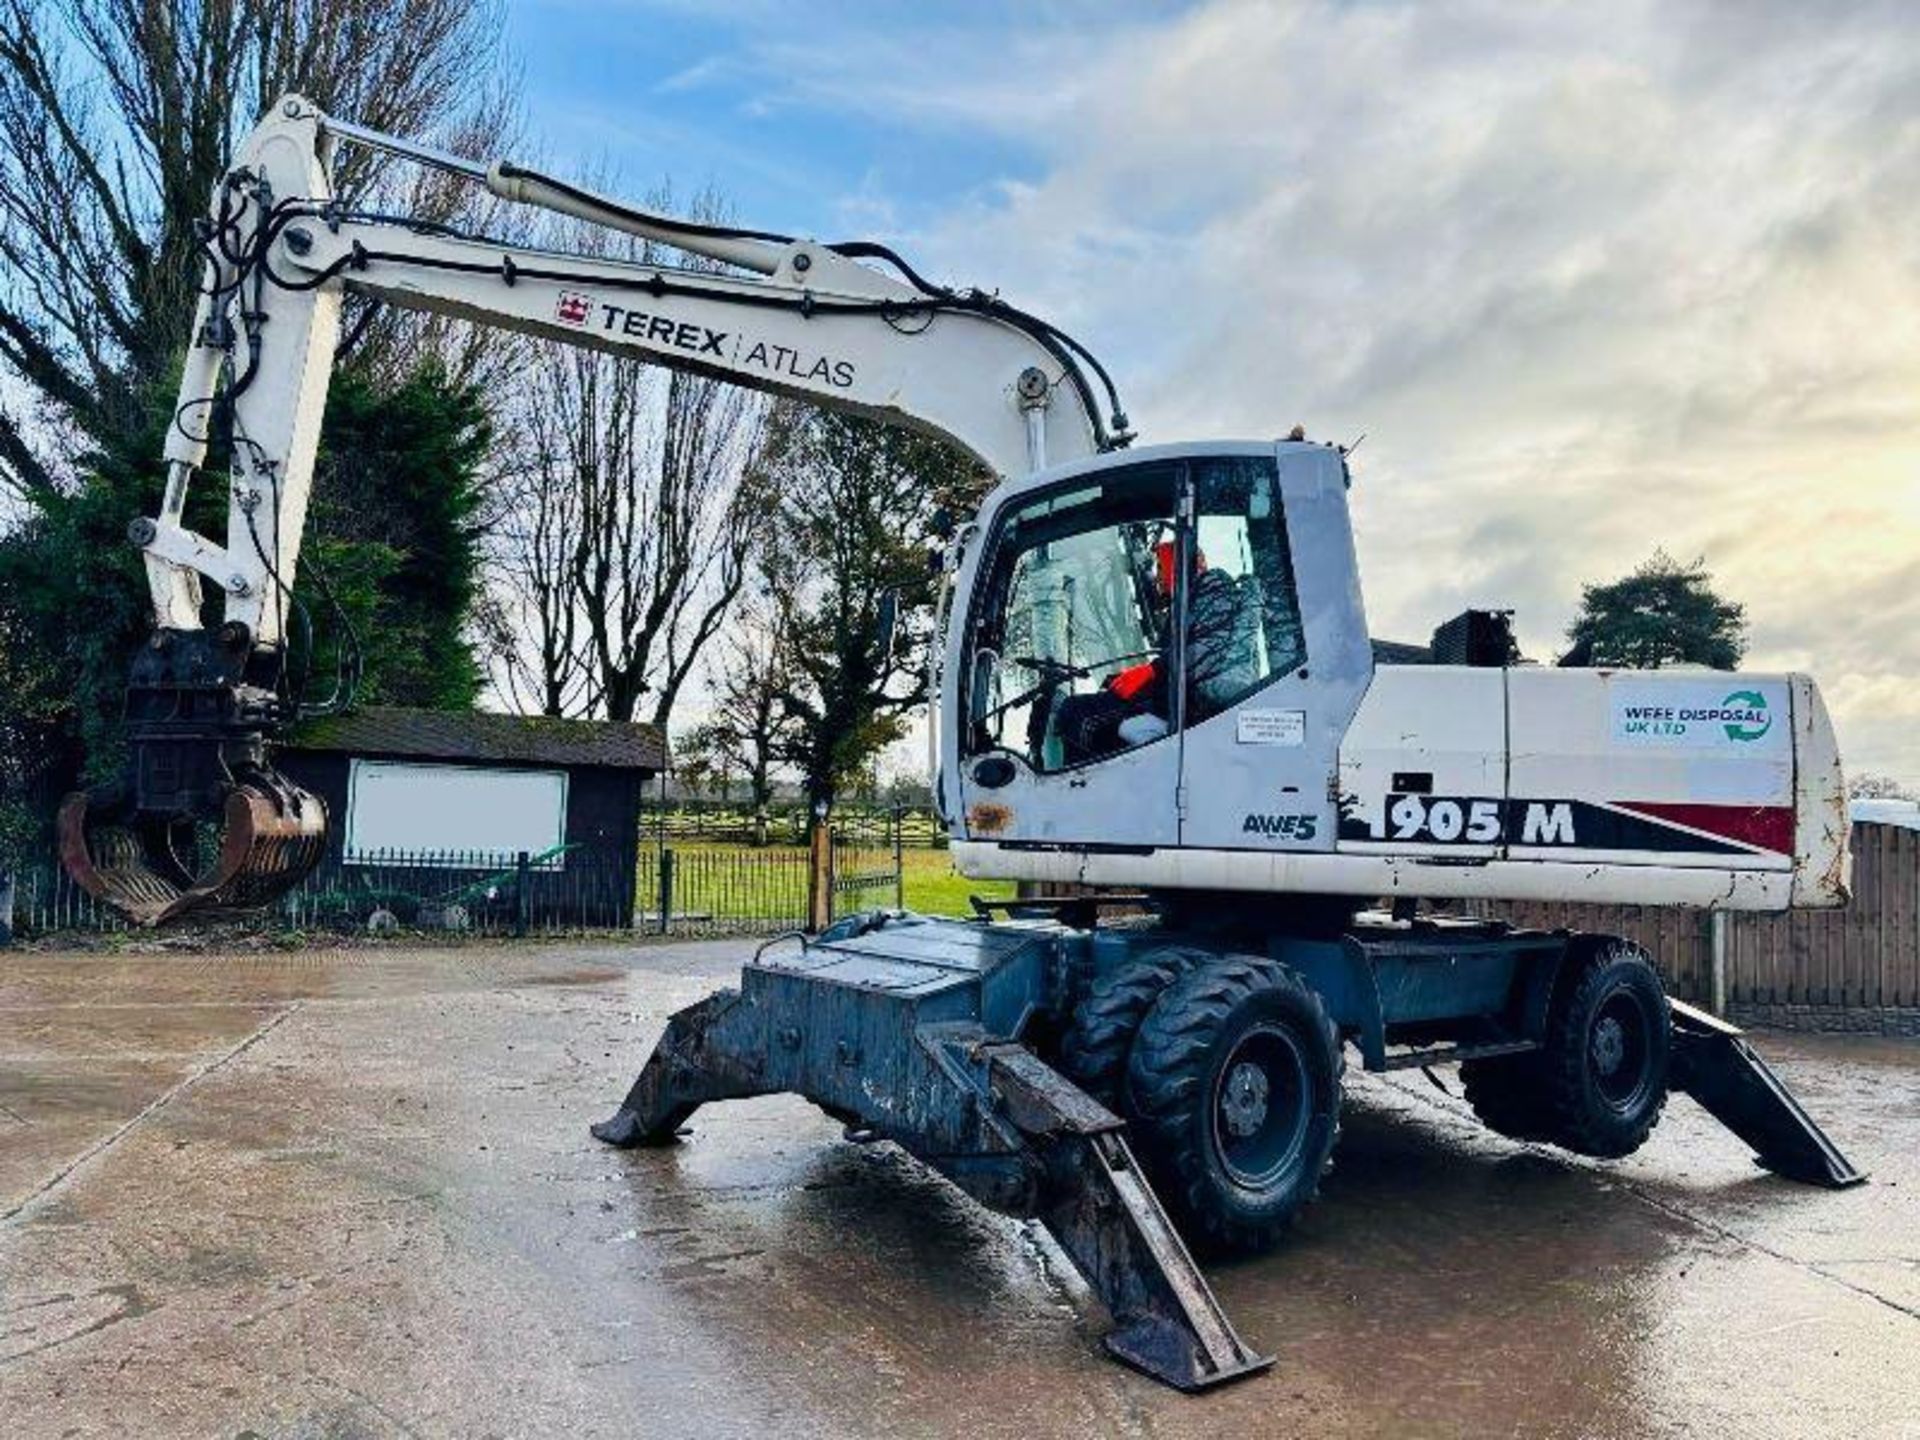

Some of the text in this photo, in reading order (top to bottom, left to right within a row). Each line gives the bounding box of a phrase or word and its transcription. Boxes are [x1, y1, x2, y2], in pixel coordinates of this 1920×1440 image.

[602, 303, 856, 388] TEREX ATLAS
[1625, 721, 1686, 735] UK LTD
[1679, 708, 1766, 724] DISPOSAL
[1369, 795, 1576, 843] 1905 M
